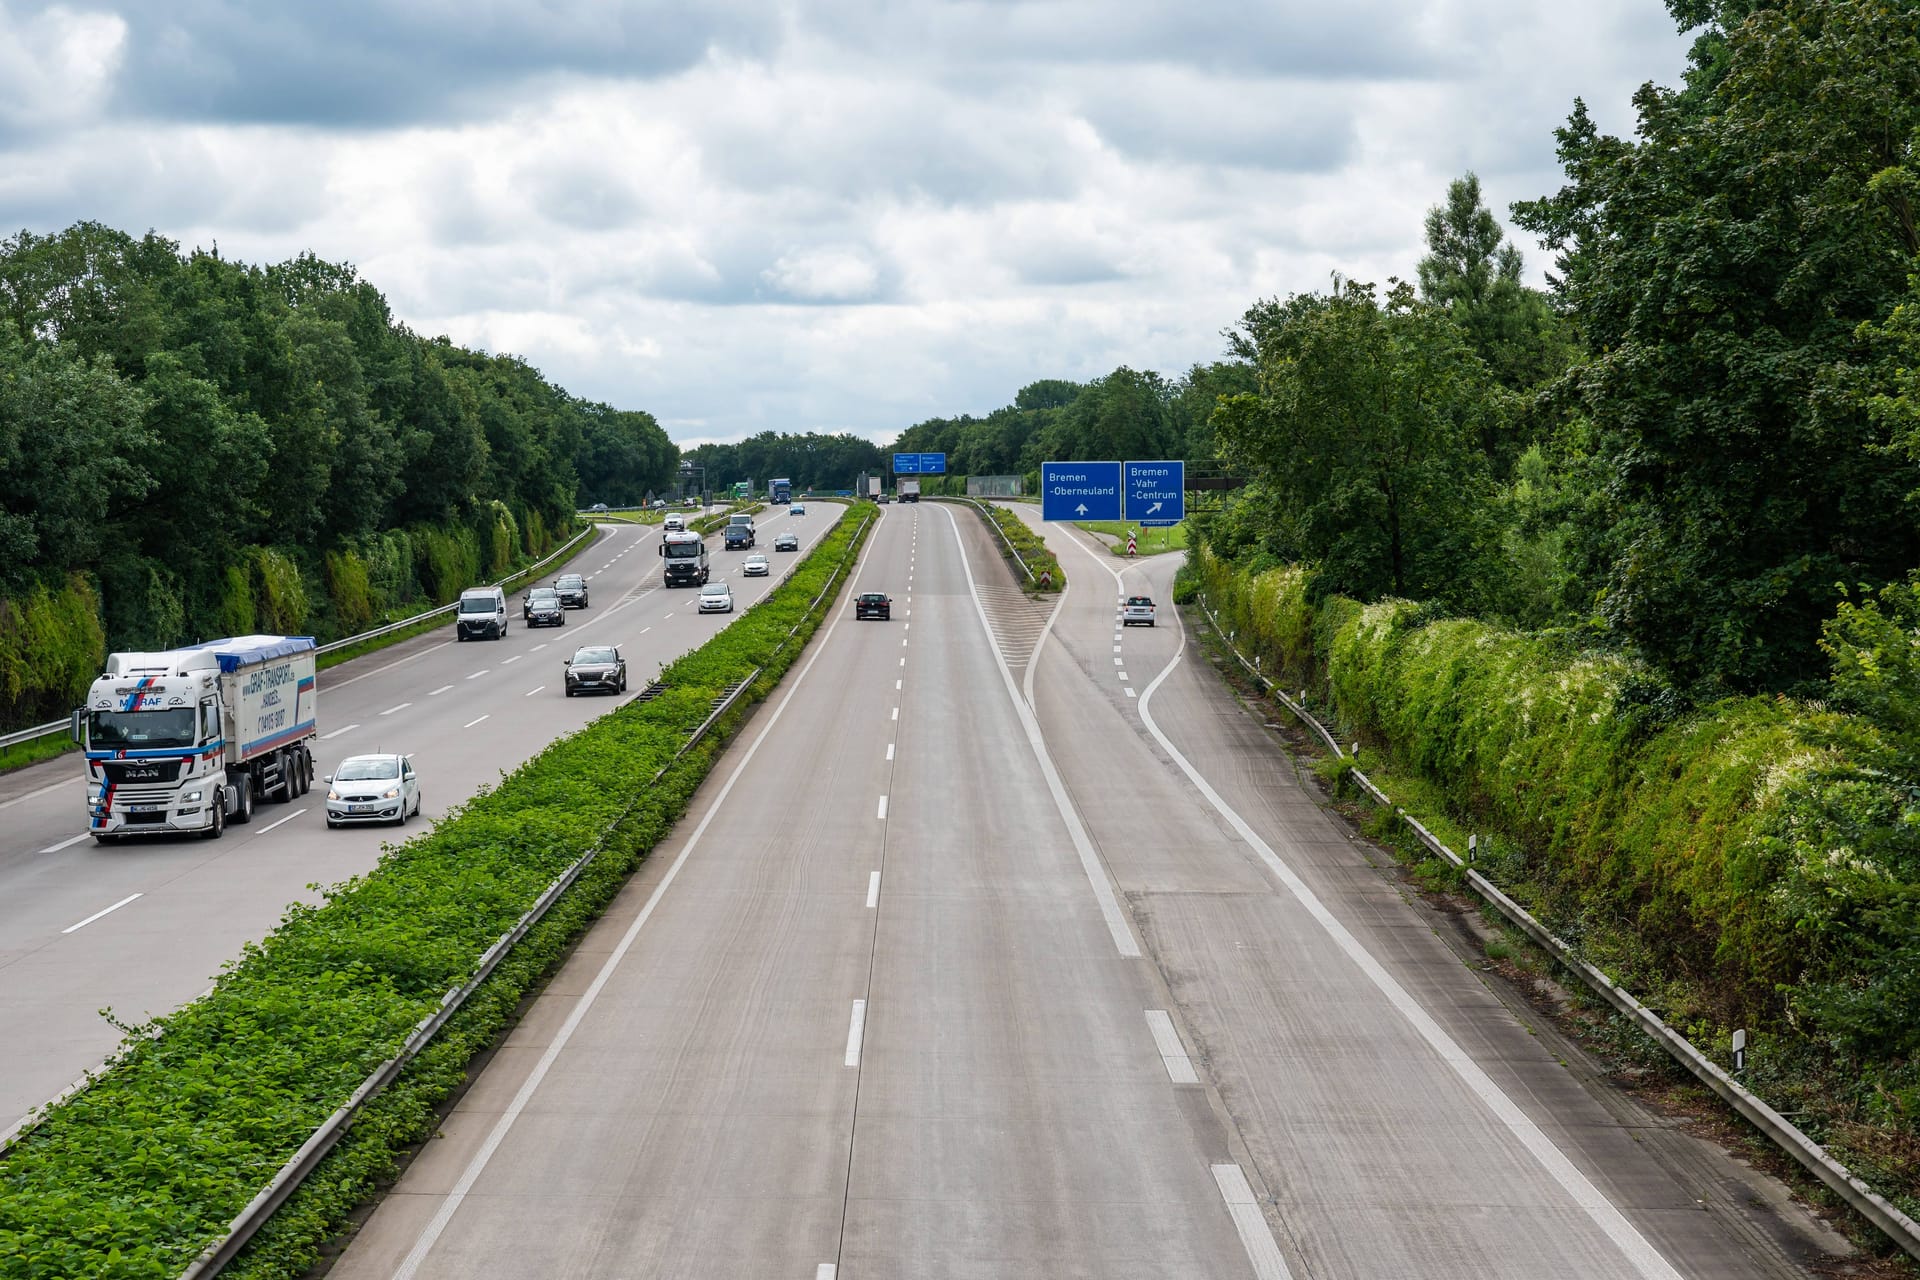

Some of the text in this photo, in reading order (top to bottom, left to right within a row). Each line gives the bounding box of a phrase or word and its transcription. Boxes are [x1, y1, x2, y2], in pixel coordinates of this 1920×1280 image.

[1131, 467, 1168, 476] Bremen
[1049, 473, 1086, 482] Bremen
[1131, 479, 1157, 488] -Vahr
[1049, 486, 1114, 495] -Oberneuland
[1131, 490, 1177, 499] -Centrum
[125, 769, 159, 778] MAN
